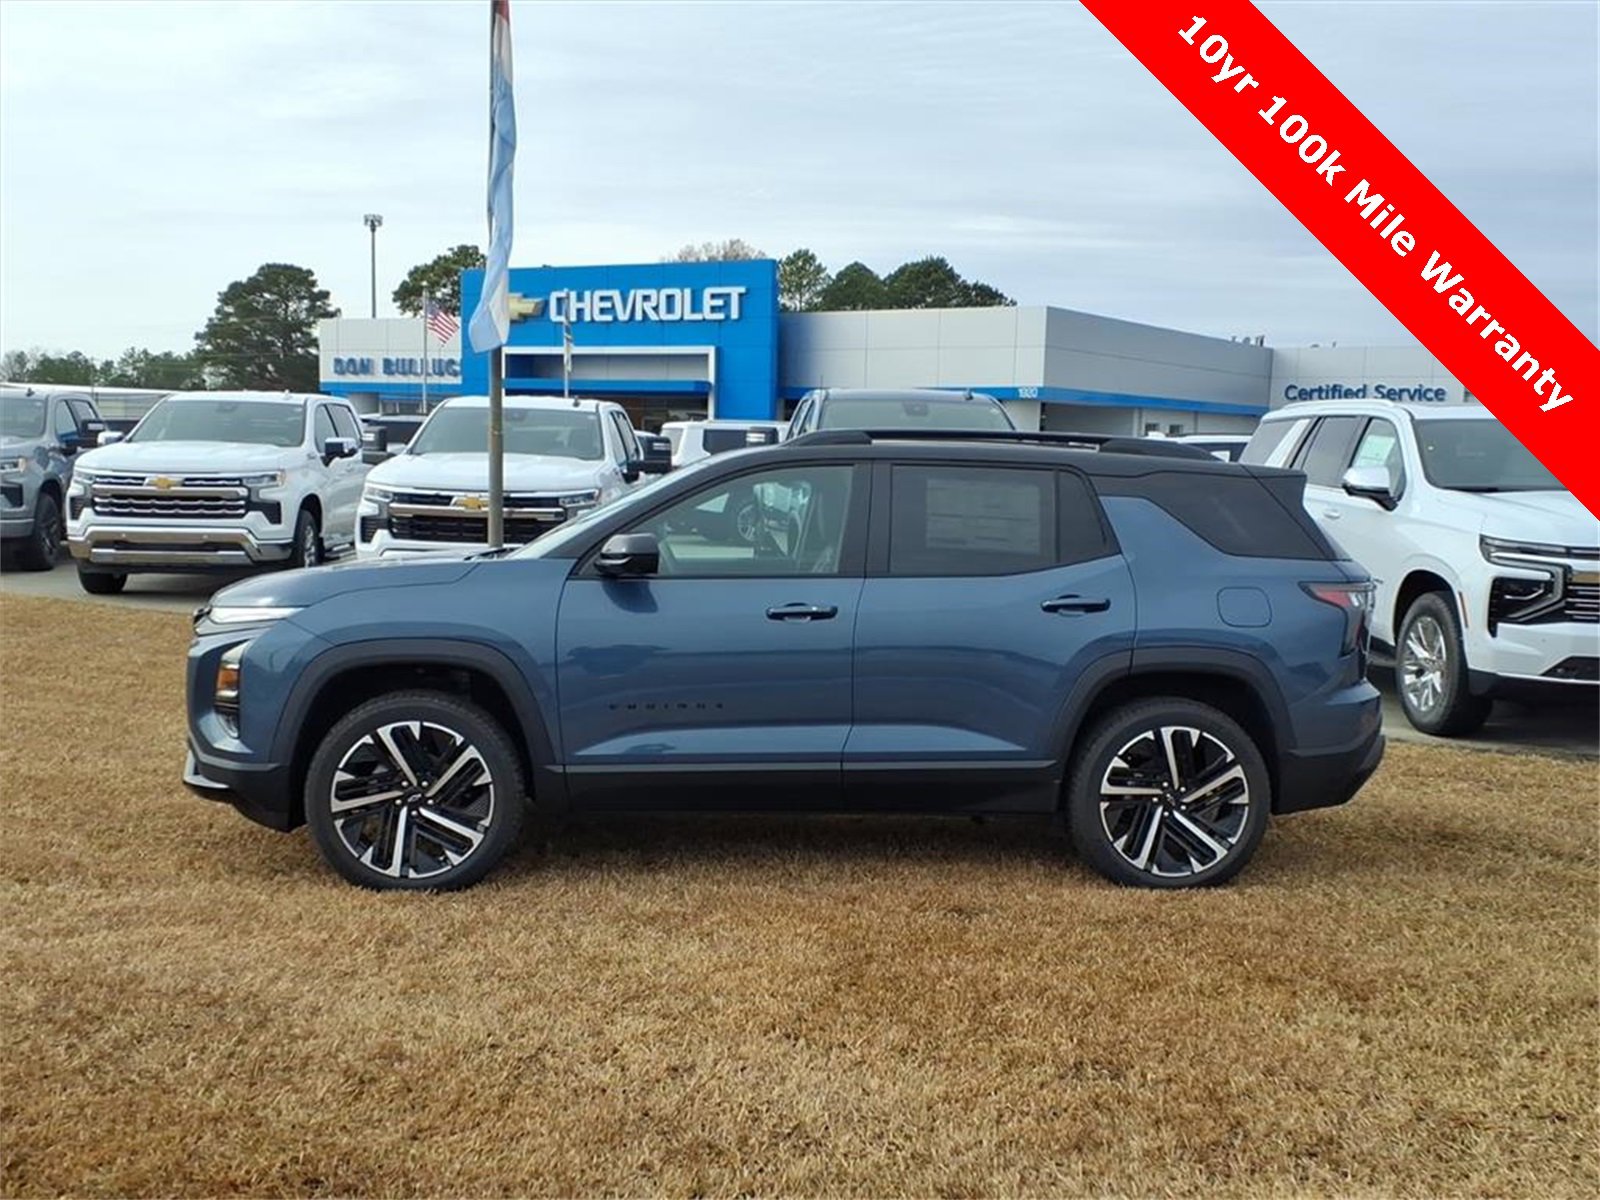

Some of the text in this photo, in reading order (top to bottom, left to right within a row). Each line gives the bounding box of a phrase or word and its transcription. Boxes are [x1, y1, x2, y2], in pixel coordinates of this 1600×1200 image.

[549, 286, 747, 322] CHEVROLET
[333, 357, 375, 376] DON
[1284, 384, 1368, 401] Certified
[1374, 384, 1447, 402] Service
